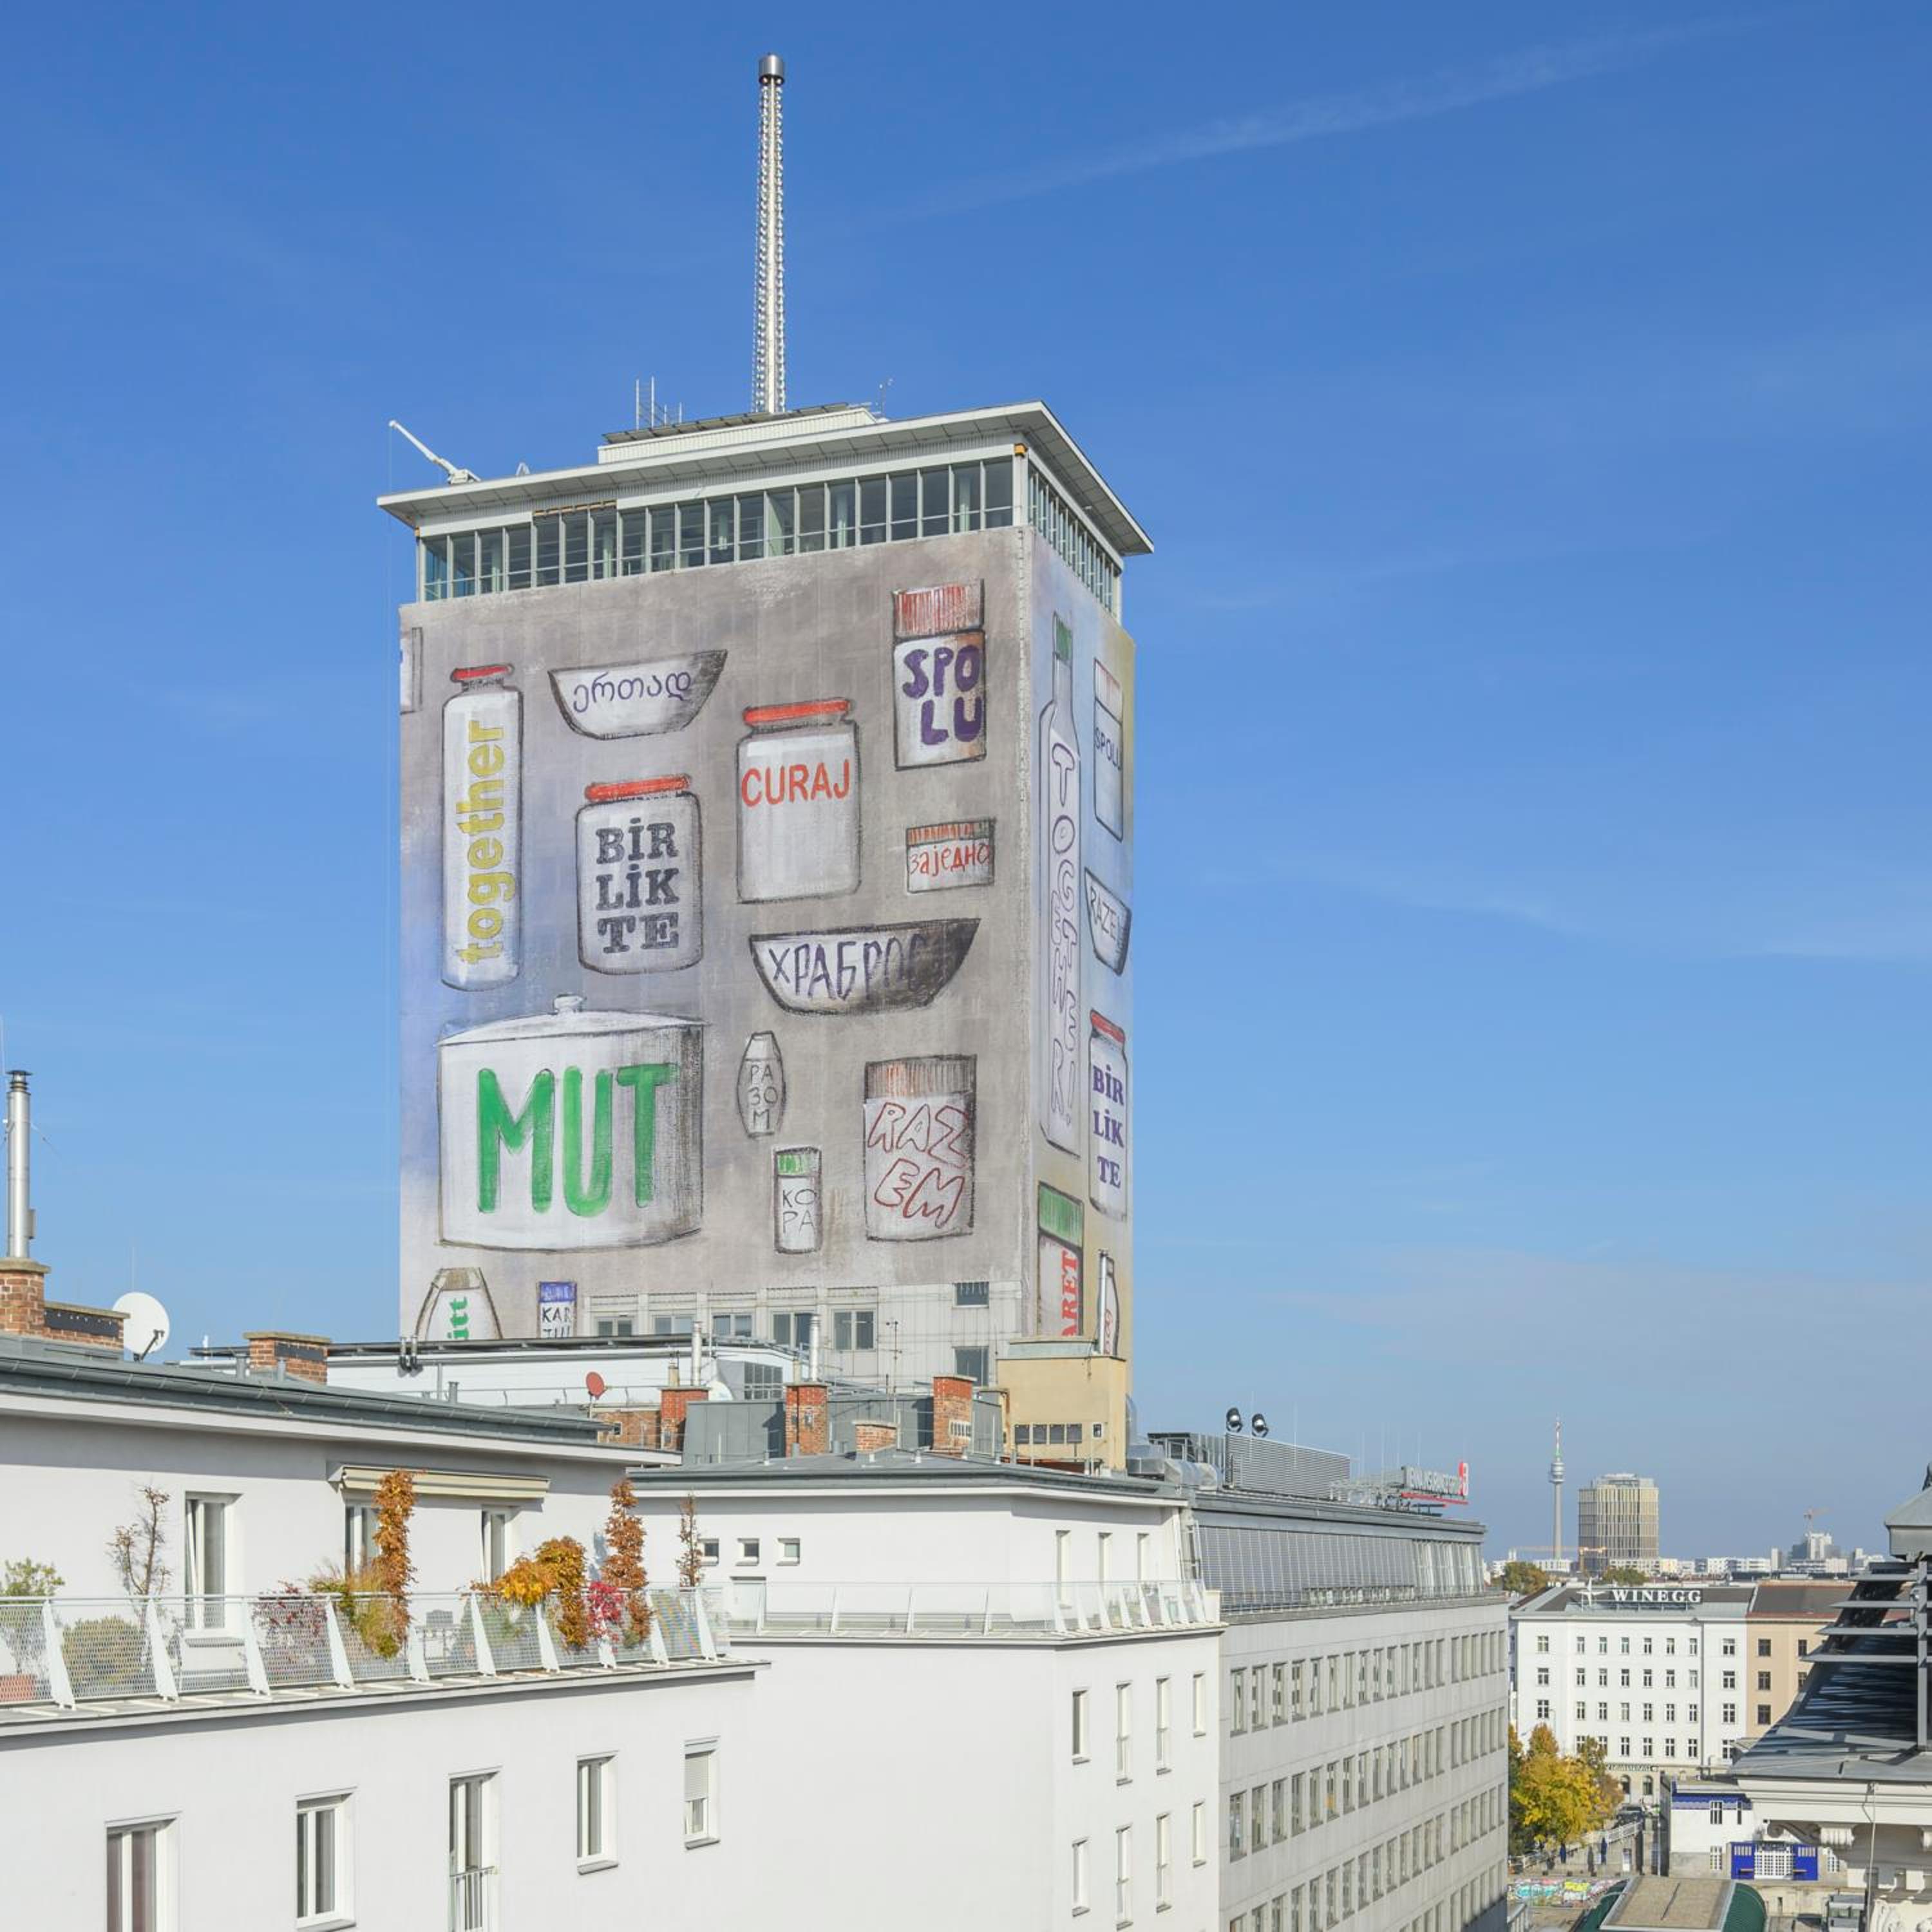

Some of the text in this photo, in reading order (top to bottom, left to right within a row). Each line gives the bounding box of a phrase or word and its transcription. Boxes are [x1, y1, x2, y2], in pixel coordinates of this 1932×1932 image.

[902, 644, 980, 699] SPO
[920, 696, 983, 746] LU
[741, 759, 850, 808] CURAJ
[456, 720, 515, 965] together
[597, 911, 679, 954] TE
[477, 1063, 680, 1217] MUT
[875, 1158, 965, 1229] EM
[1097, 1155, 1121, 1189] TE
[1612, 1589, 1701, 1603] WINEGG
